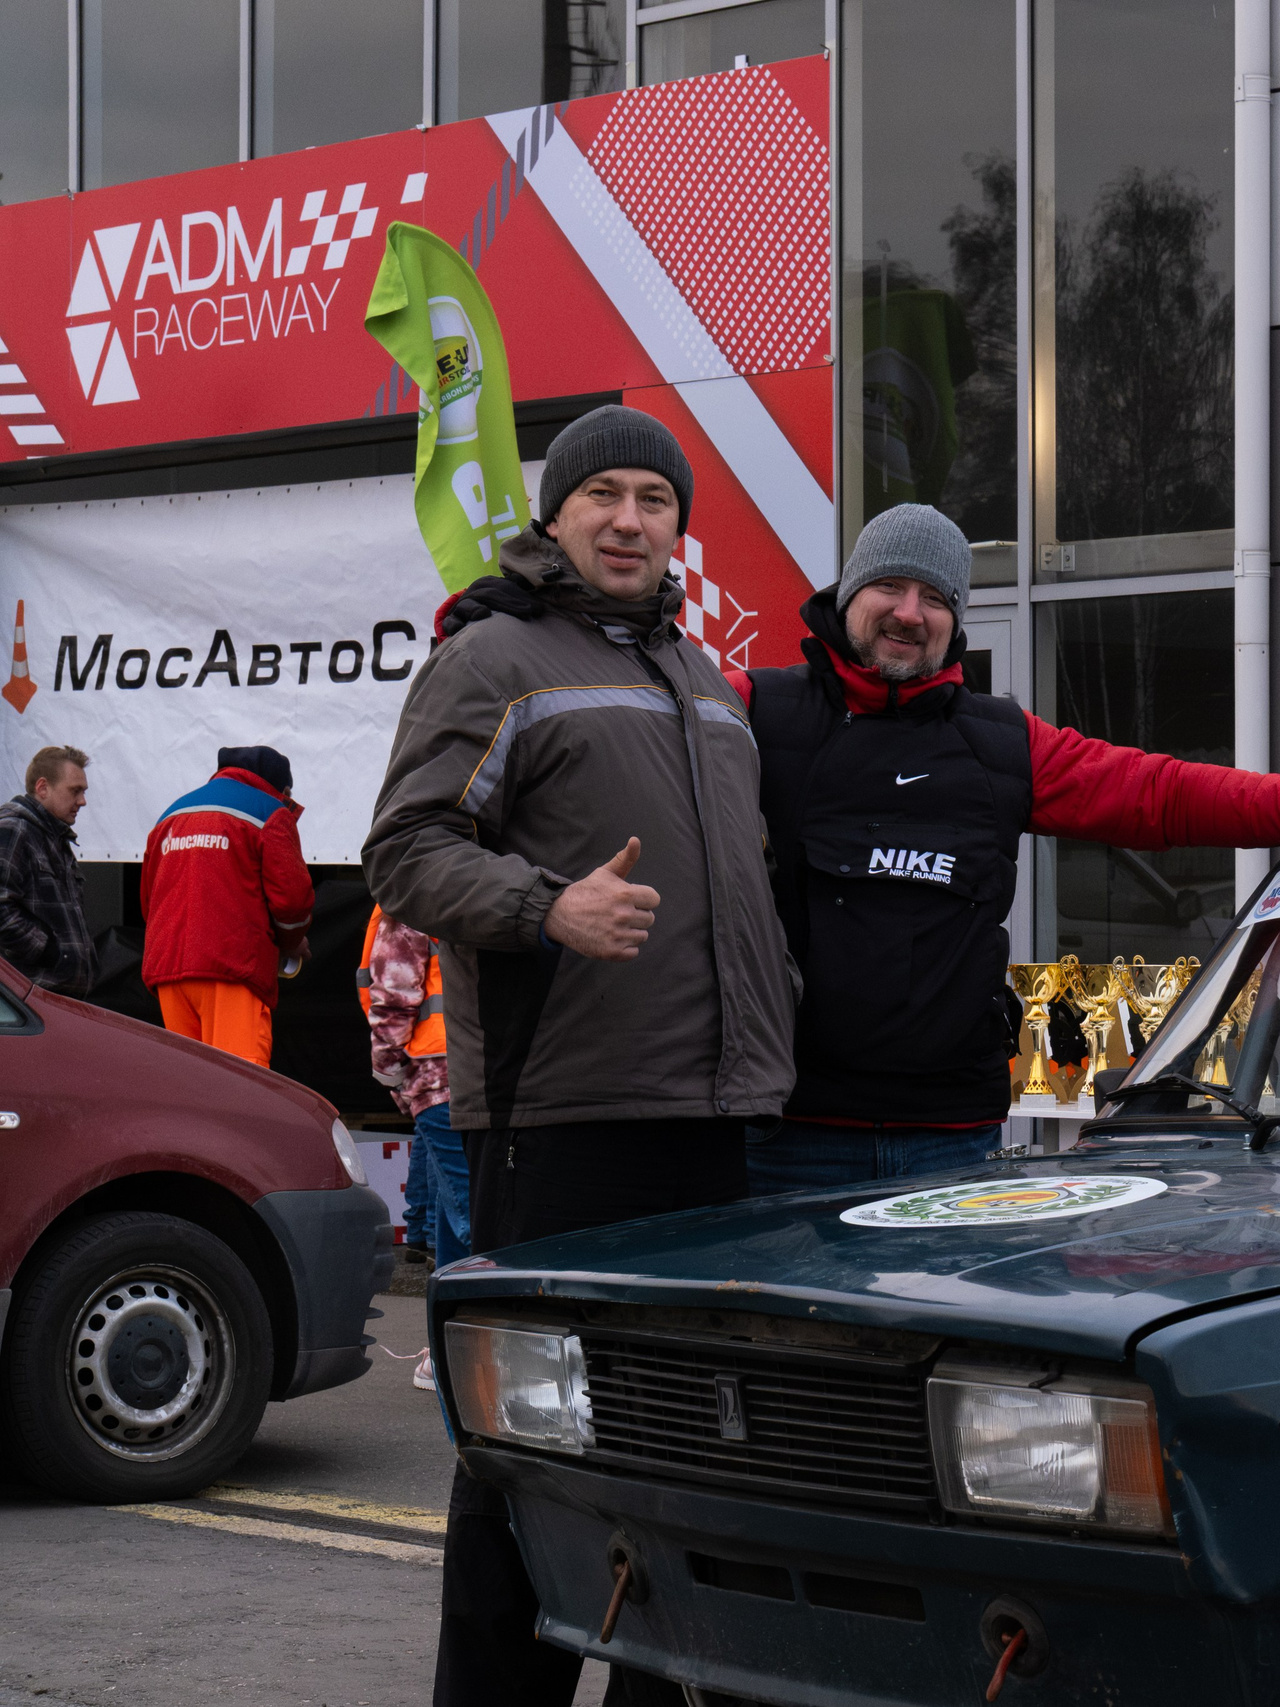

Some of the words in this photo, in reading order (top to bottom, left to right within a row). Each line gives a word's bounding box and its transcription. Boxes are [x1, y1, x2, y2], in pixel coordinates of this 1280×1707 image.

[134, 197, 283, 301] ADM
[133, 278, 341, 358] RACEWAY
[54, 620, 438, 691] МосАвтоС
[170, 834, 229, 851] МОСЭНЕРГО
[868, 848, 956, 876] NIKE
[889, 868, 912, 878] NIKE
[912, 871, 951, 885] RUNNING
